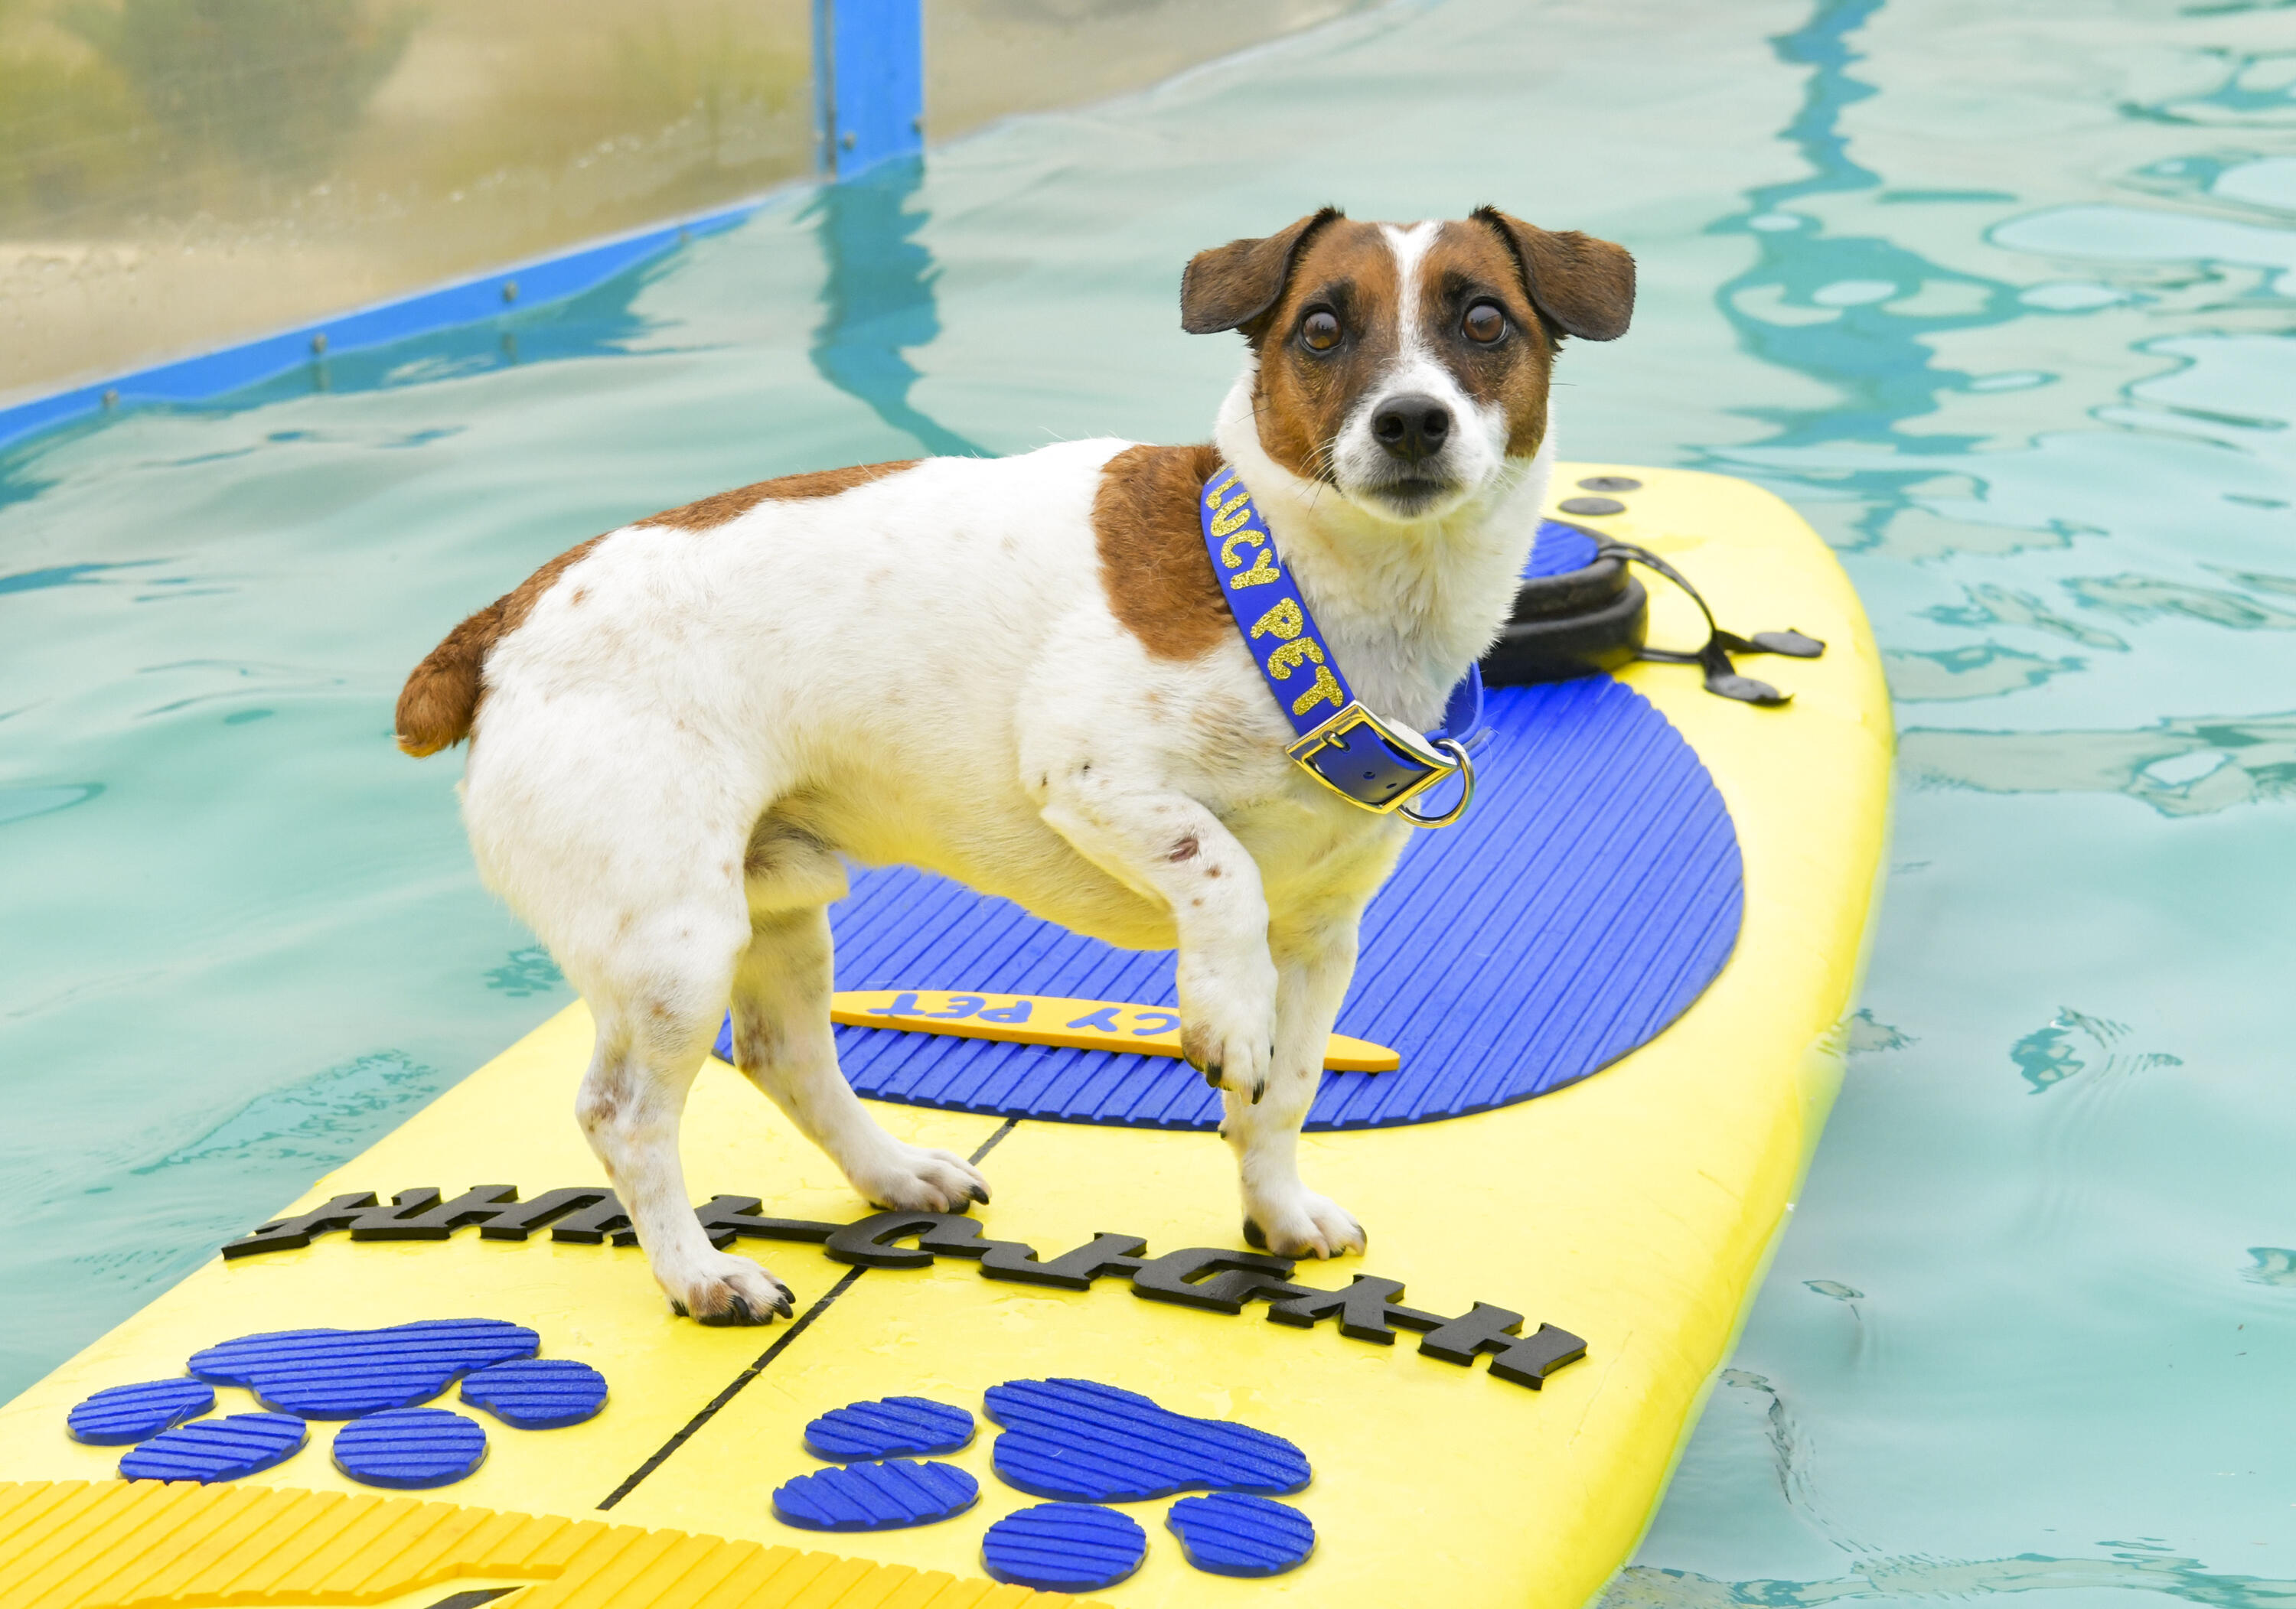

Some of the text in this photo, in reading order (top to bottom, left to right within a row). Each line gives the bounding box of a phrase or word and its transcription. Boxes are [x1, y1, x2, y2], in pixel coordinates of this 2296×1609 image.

[1205, 474, 1344, 716] LUCY PET
[868, 992, 1181, 1035] CY PET
